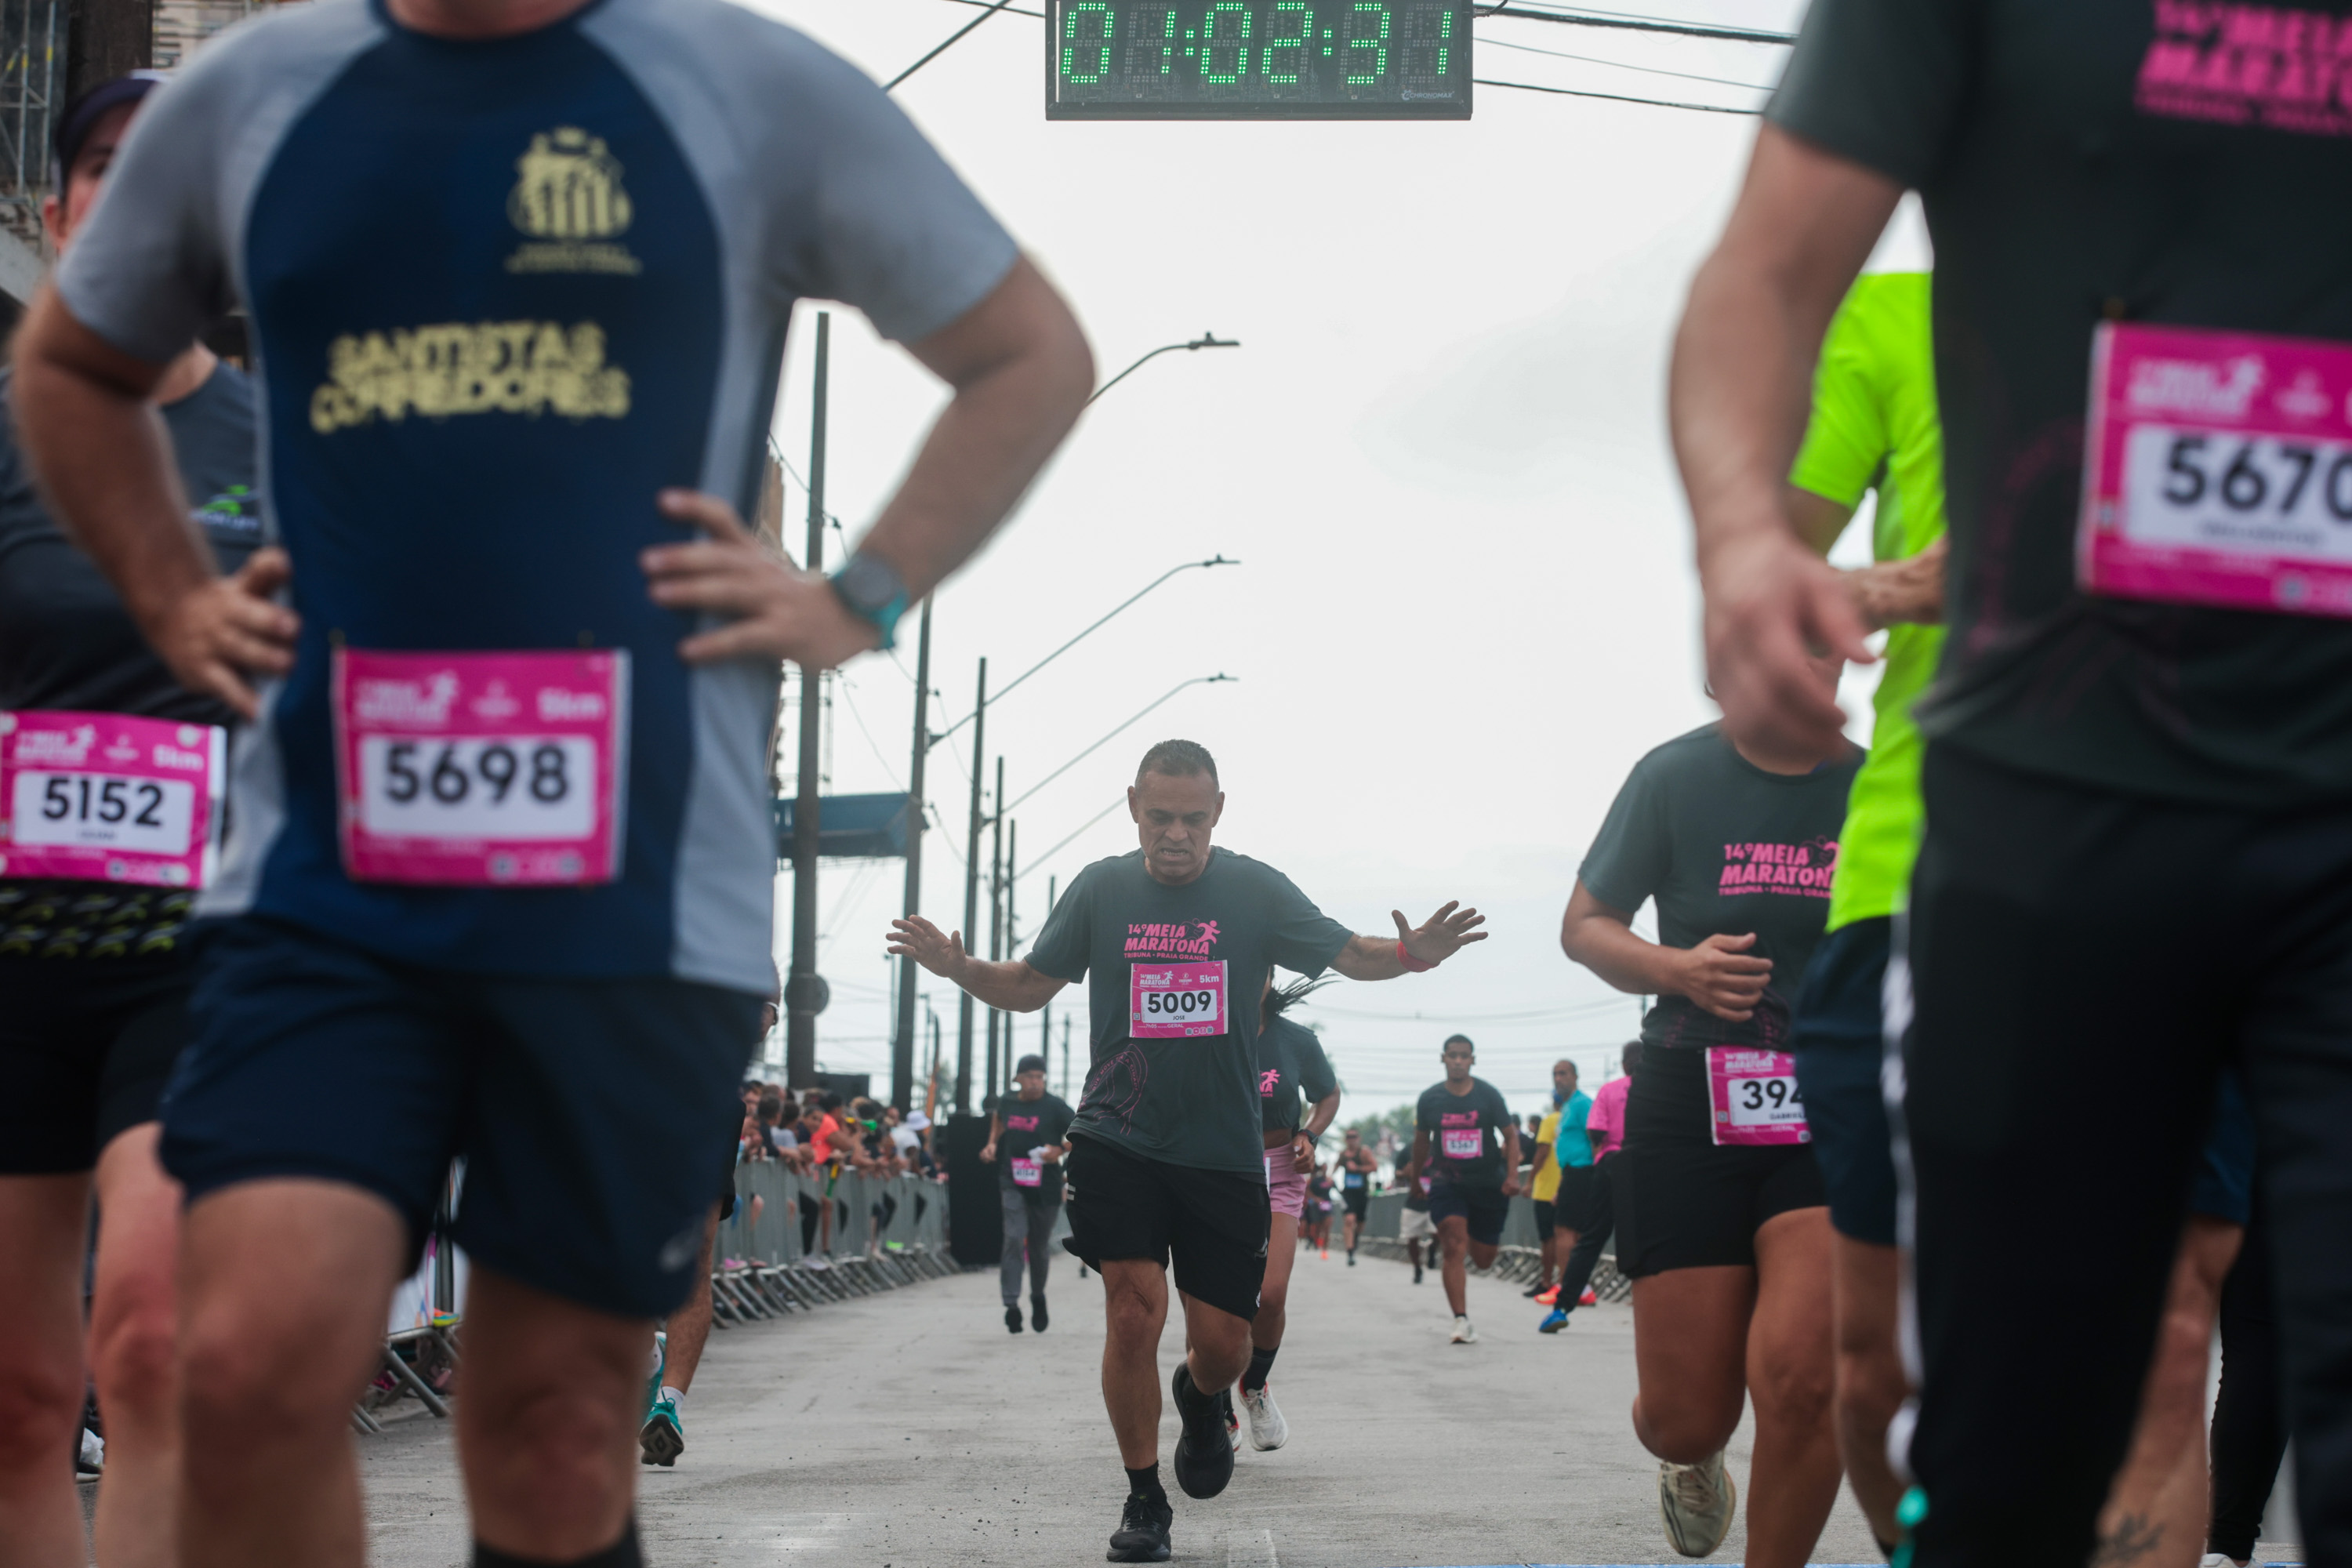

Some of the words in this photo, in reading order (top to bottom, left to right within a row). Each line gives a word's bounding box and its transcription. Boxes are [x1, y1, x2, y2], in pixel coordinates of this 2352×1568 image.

[1062, 2, 1452, 84] 01:02:31
[387, 743, 568, 805] 5698
[42, 777, 163, 827] 5152
[1751, 843, 1809, 866] MEIA
[1719, 863, 1835, 888] MARATON
[1145, 924, 1186, 938] MEIA
[1124, 938, 1210, 955] MARATONA
[1200, 975, 1219, 983] 5km
[1147, 991, 1211, 1014] 5009
